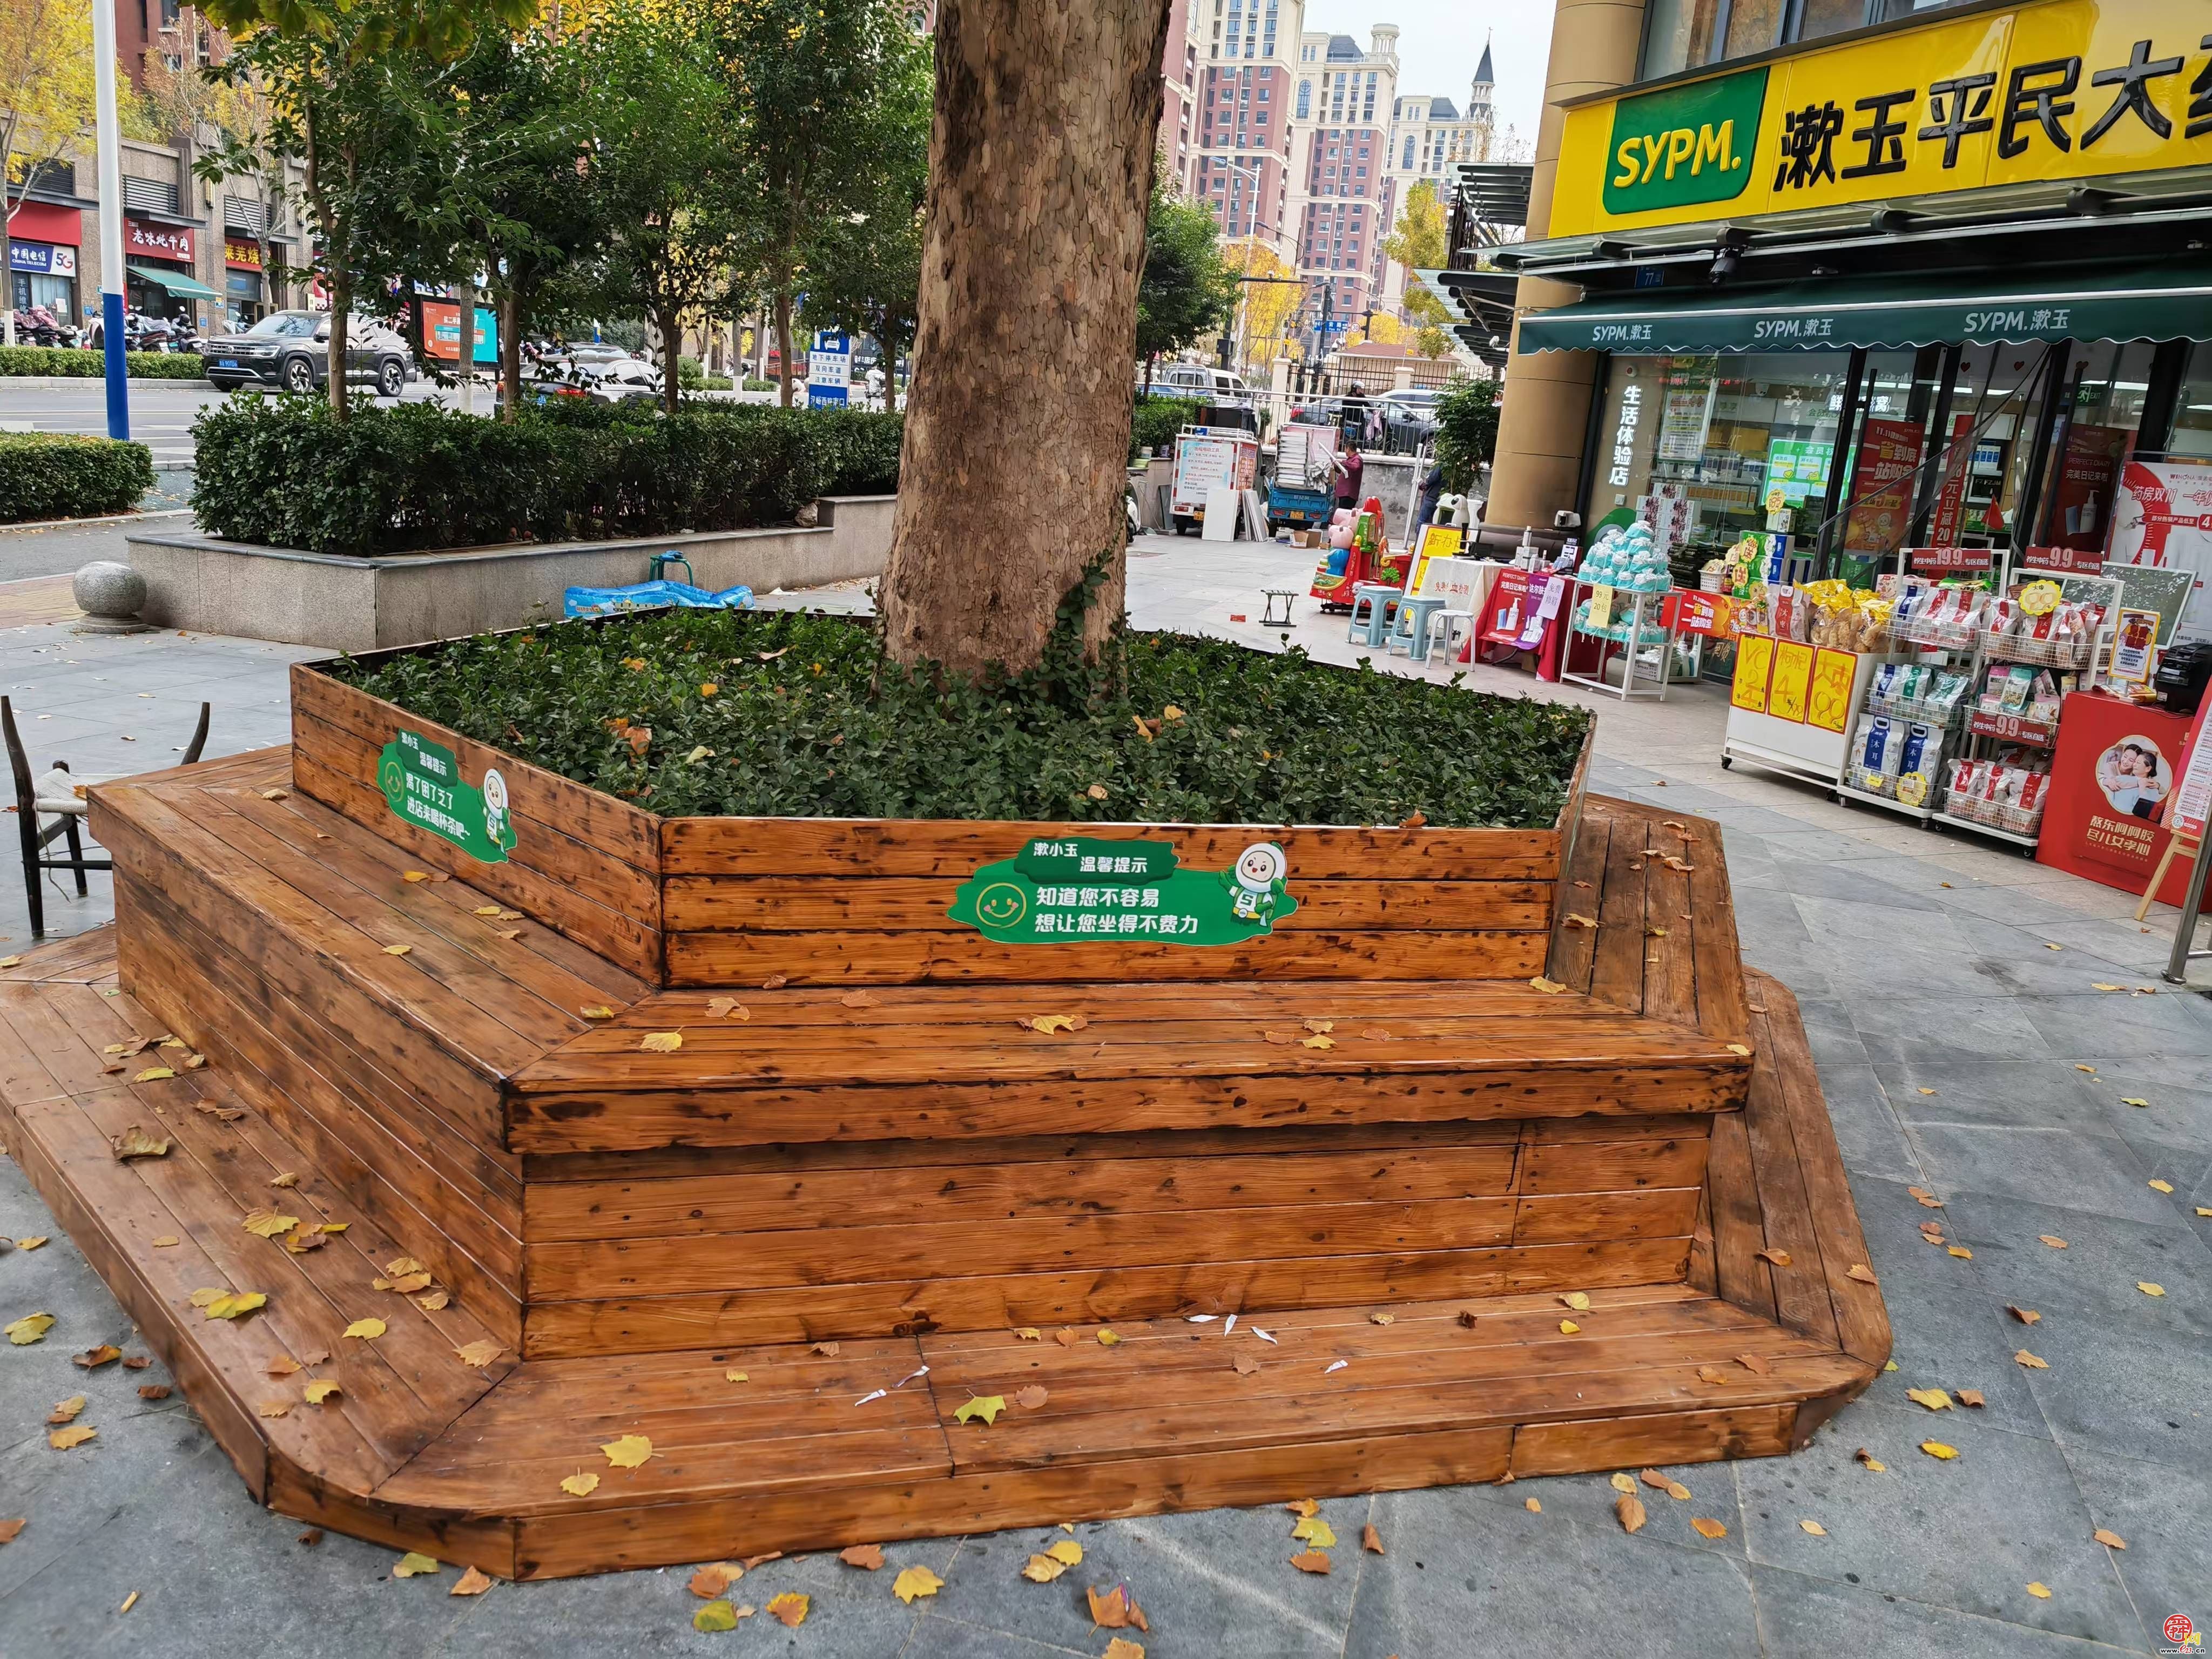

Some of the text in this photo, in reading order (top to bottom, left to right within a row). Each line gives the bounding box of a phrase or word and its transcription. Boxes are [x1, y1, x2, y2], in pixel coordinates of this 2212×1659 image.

[1613, 119, 1741, 188] SYPM.
[11, 247, 46, 261] 中国电信
[56, 253, 73, 269] 5G
[812, 354, 847, 363] 地下停车场
[815, 366, 841, 374] 双向车道
[815, 376, 841, 385] 注意车辆
[1609, 385, 1642, 486] 生活体验店
[2069, 458, 2093, 466] PERFECT
[2132, 487, 2177, 510] 药房双11
[1871, 739, 1879, 760] 木耳
[1907, 748, 1917, 769] 木耳
[419, 751, 447, 777] 温馨提示
[406, 772, 453, 810] 渴了困了乏了
[2090, 815, 2155, 843] 熬东阿阿胶
[1034, 842, 1078, 858] 漱小玉
[2087, 828, 2151, 856] 尽儿女孝心
[1080, 857, 1147, 873] 温馨提示
[1036, 887, 1160, 908] 知道您不容易
[1034, 914, 1199, 934] 想让您坐得不费力
